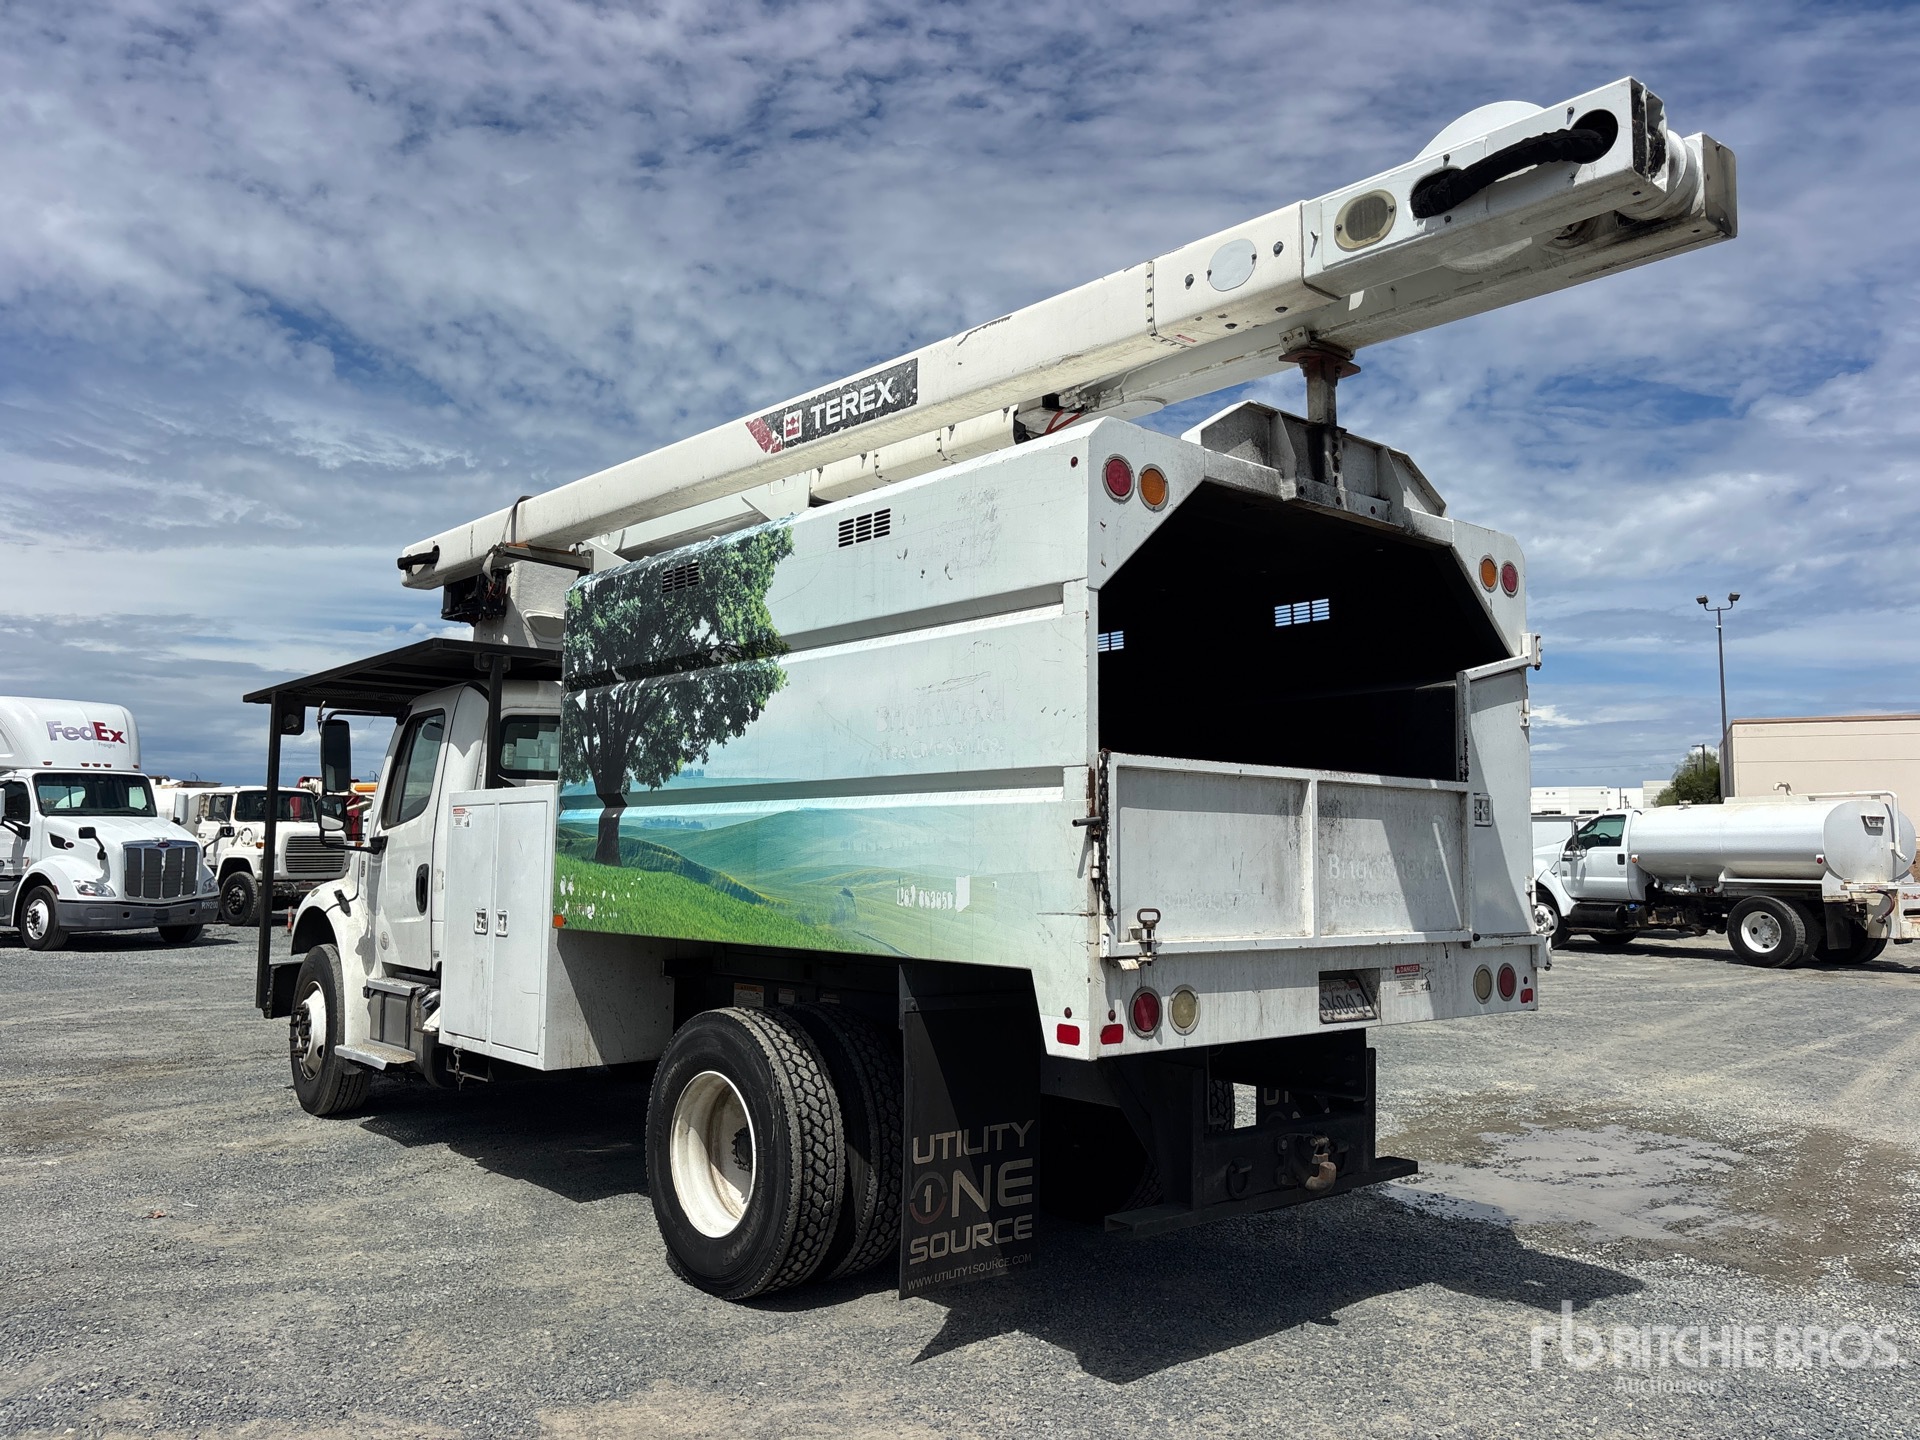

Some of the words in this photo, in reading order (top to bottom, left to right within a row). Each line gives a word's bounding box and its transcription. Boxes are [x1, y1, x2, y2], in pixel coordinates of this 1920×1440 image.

[810, 377, 896, 430] TEREX
[46, 720, 127, 745] FedEx
[912, 1119, 1036, 1165] UTILITY
[909, 1213, 1033, 1266] SOURCE
[907, 1252, 1033, 1291] WWW.UTILITY1SOURCE.COM
